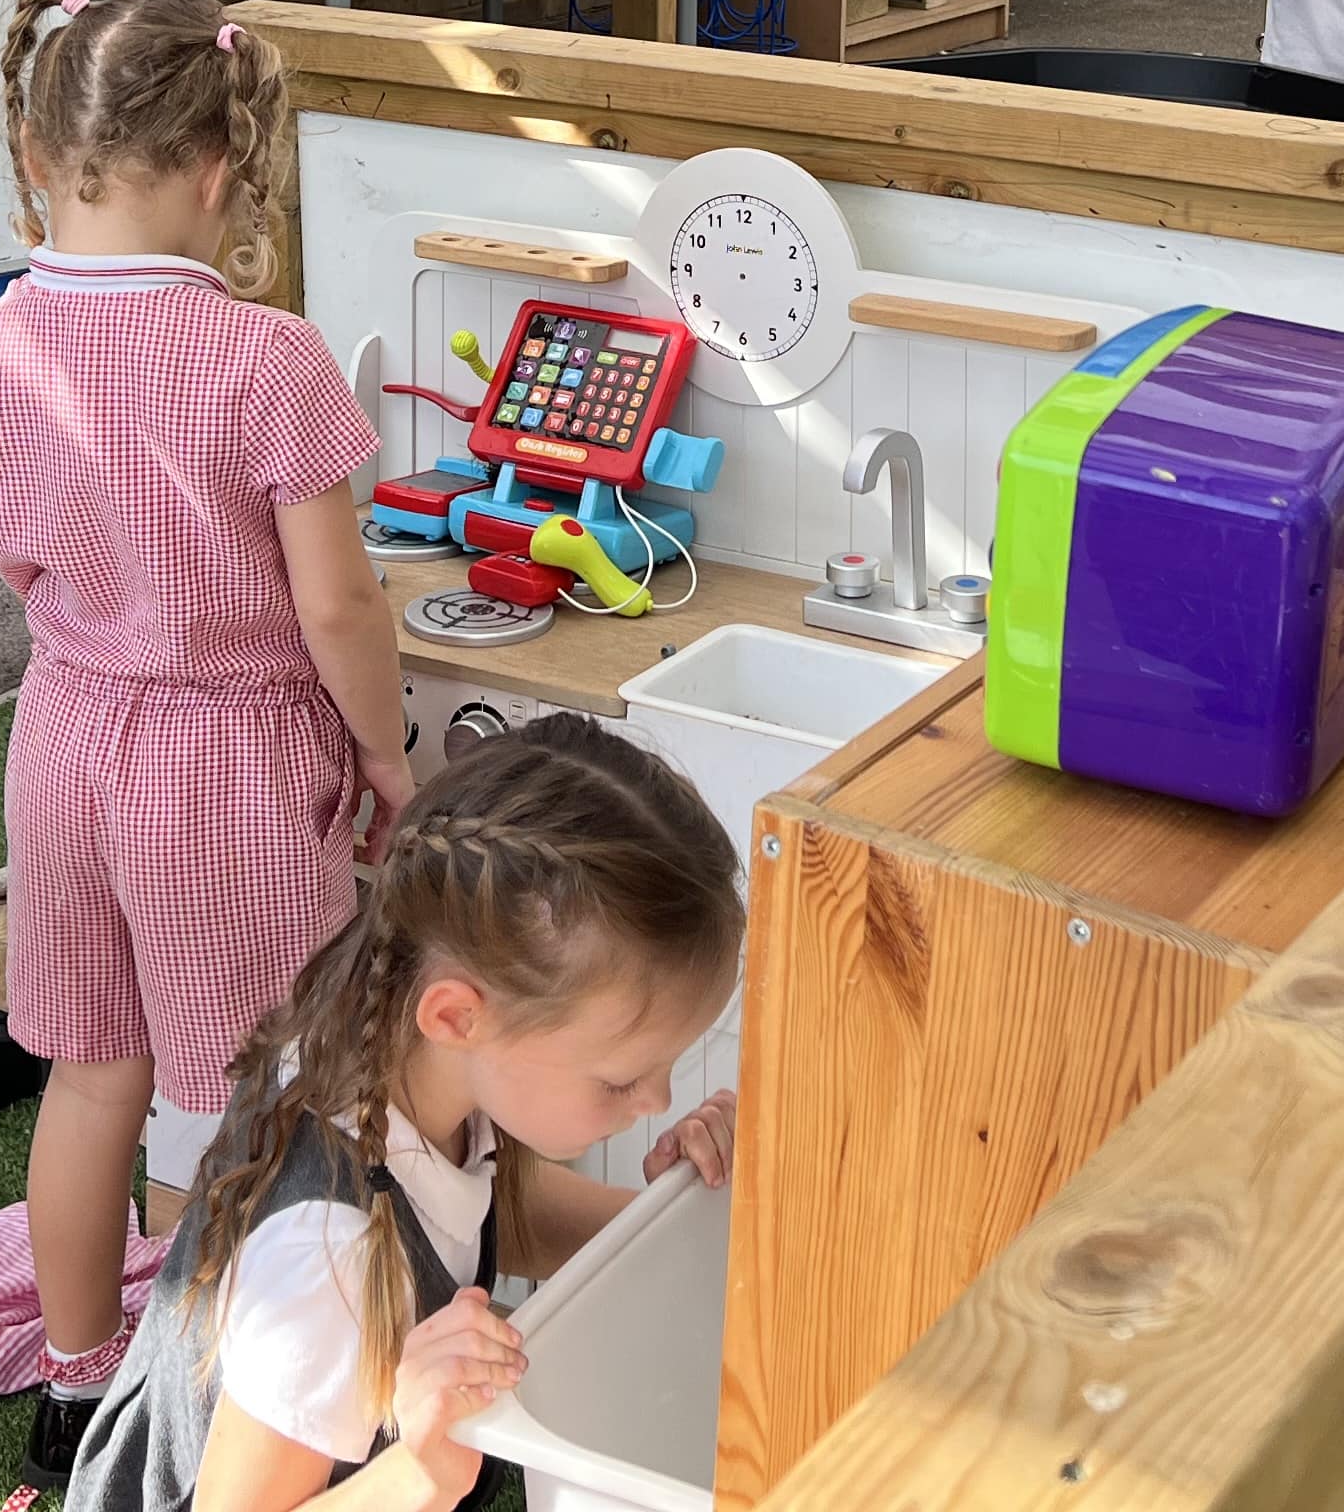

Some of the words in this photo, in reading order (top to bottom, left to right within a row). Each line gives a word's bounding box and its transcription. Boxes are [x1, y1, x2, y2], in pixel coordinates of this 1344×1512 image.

[708, 213, 722, 228] 11
[736, 209, 752, 224] 12
[770, 221, 776, 235] 1
[690, 233, 706, 248] 10
[788, 245, 797, 260] 2
[684, 263, 693, 277] 9
[793, 278, 802, 292] 3
[693, 294, 701, 308] 8
[788, 308, 797, 322] 4
[712, 320, 720, 333] 7
[739, 331, 747, 345] 6
[768, 328, 777, 341] 5
[520, 439, 545, 452] Cash
[545, 443, 584, 458] Register
